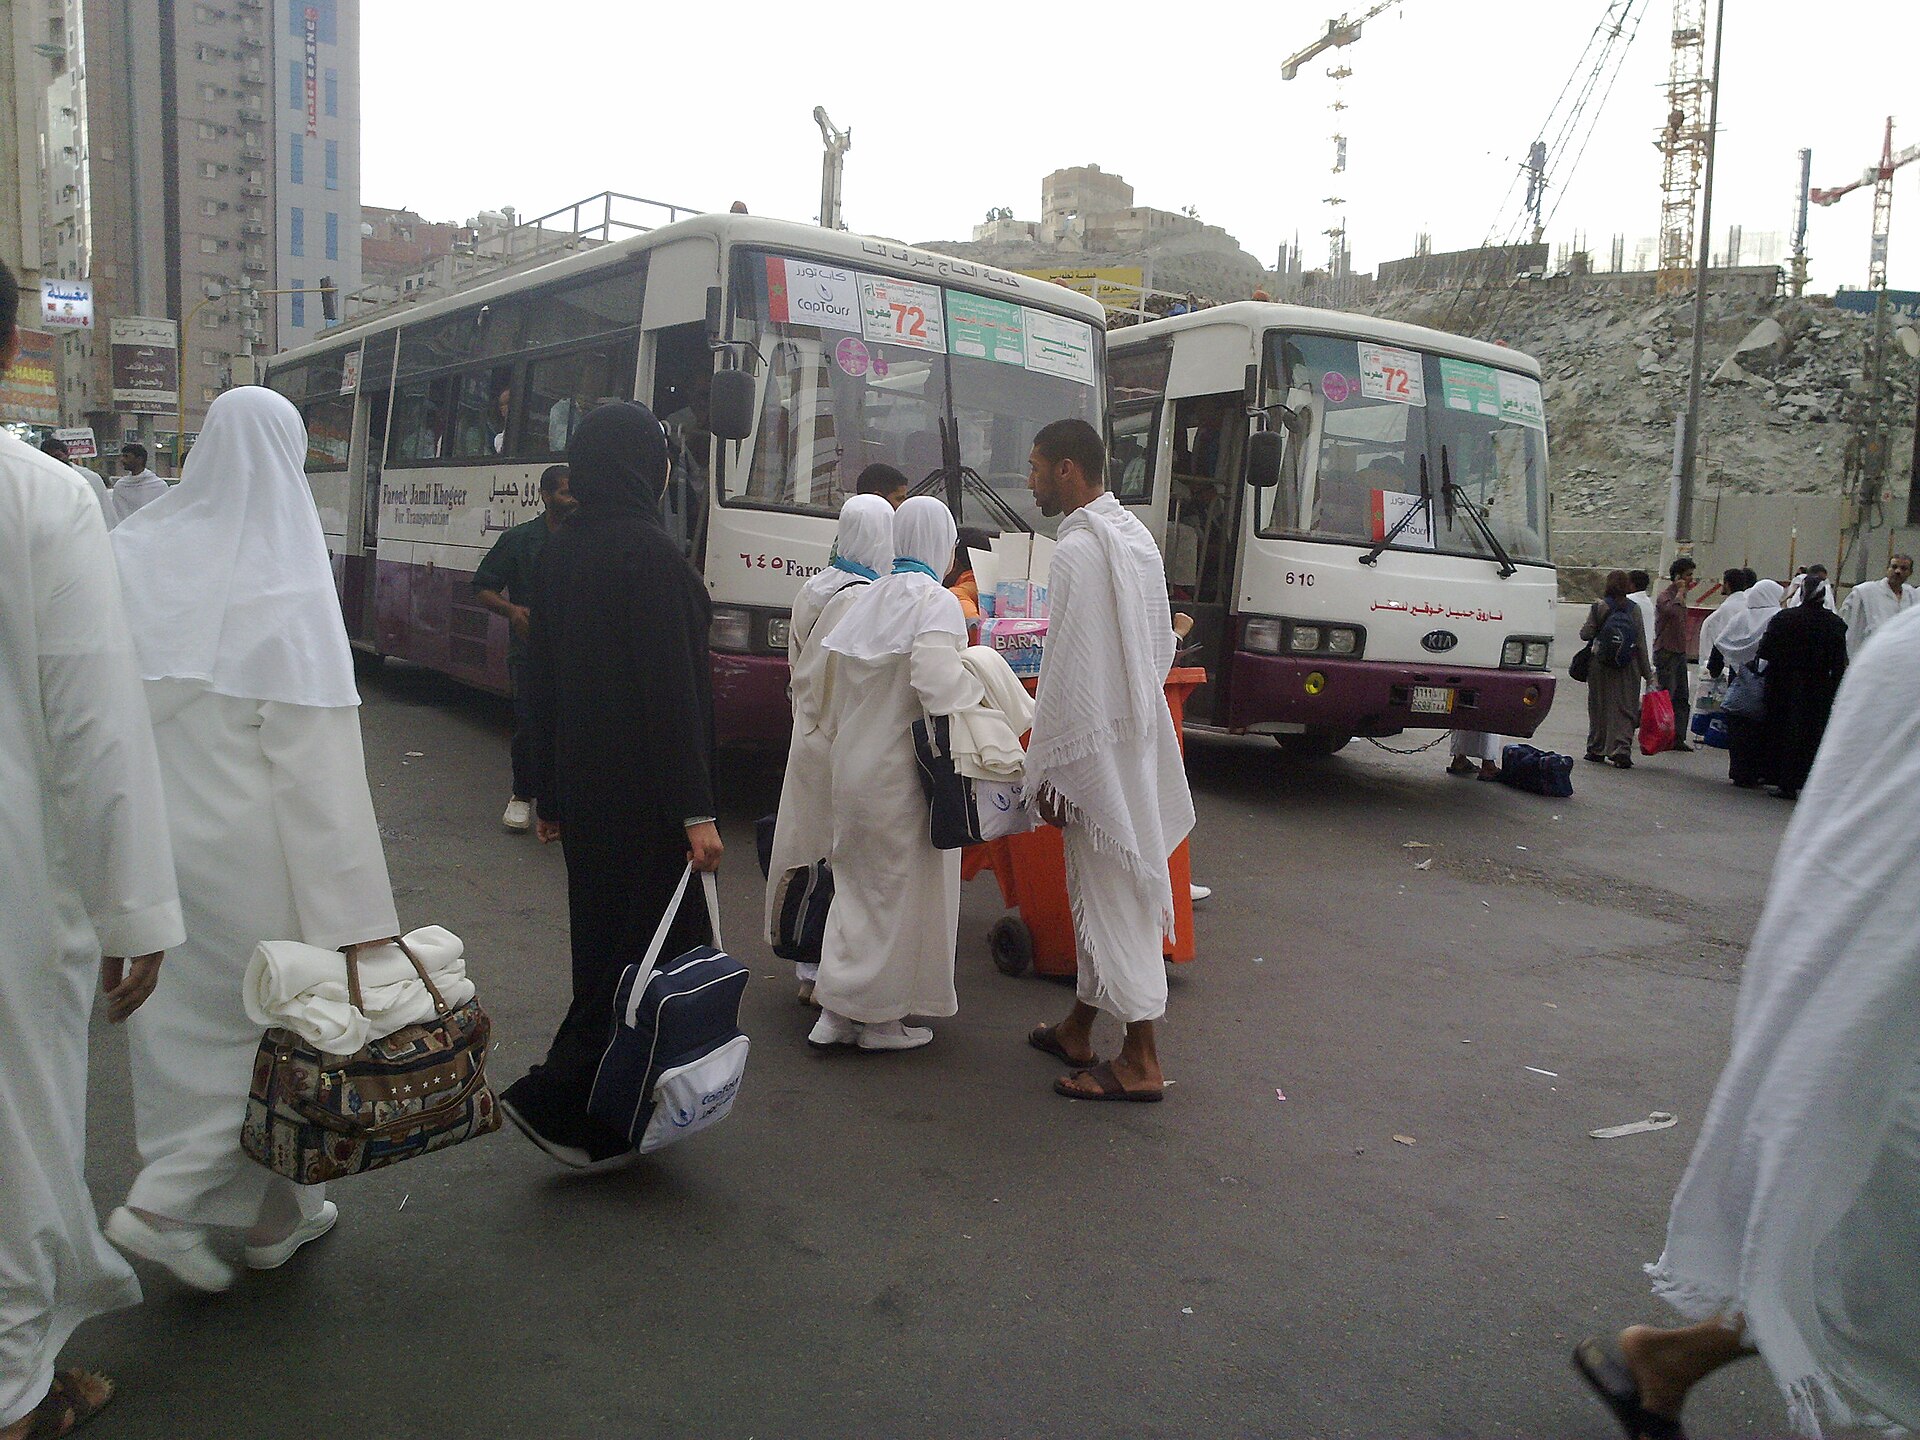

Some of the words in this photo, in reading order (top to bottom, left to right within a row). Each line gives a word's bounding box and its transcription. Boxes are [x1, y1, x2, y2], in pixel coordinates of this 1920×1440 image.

[861, 241, 887, 257] لنا
[892, 249, 935, 268] شرف
[938, 261, 978, 277] الحاج
[983, 268, 1020, 288] خدمة
[45, 282, 89, 301] مغسلة
[797, 297, 851, 317] CapTours
[45, 314, 82, 325] LAUNDRY
[889, 302, 928, 339] 72
[1382, 366, 1410, 394] 72
[411, 483, 432, 506] Jamil
[489, 475, 519, 504] جميل
[406, 507, 450, 528] Transportation
[1390, 521, 1427, 537] CpTours
[740, 553, 783, 569] ٦٤٥
[1428, 634, 1452, 649] KIA
